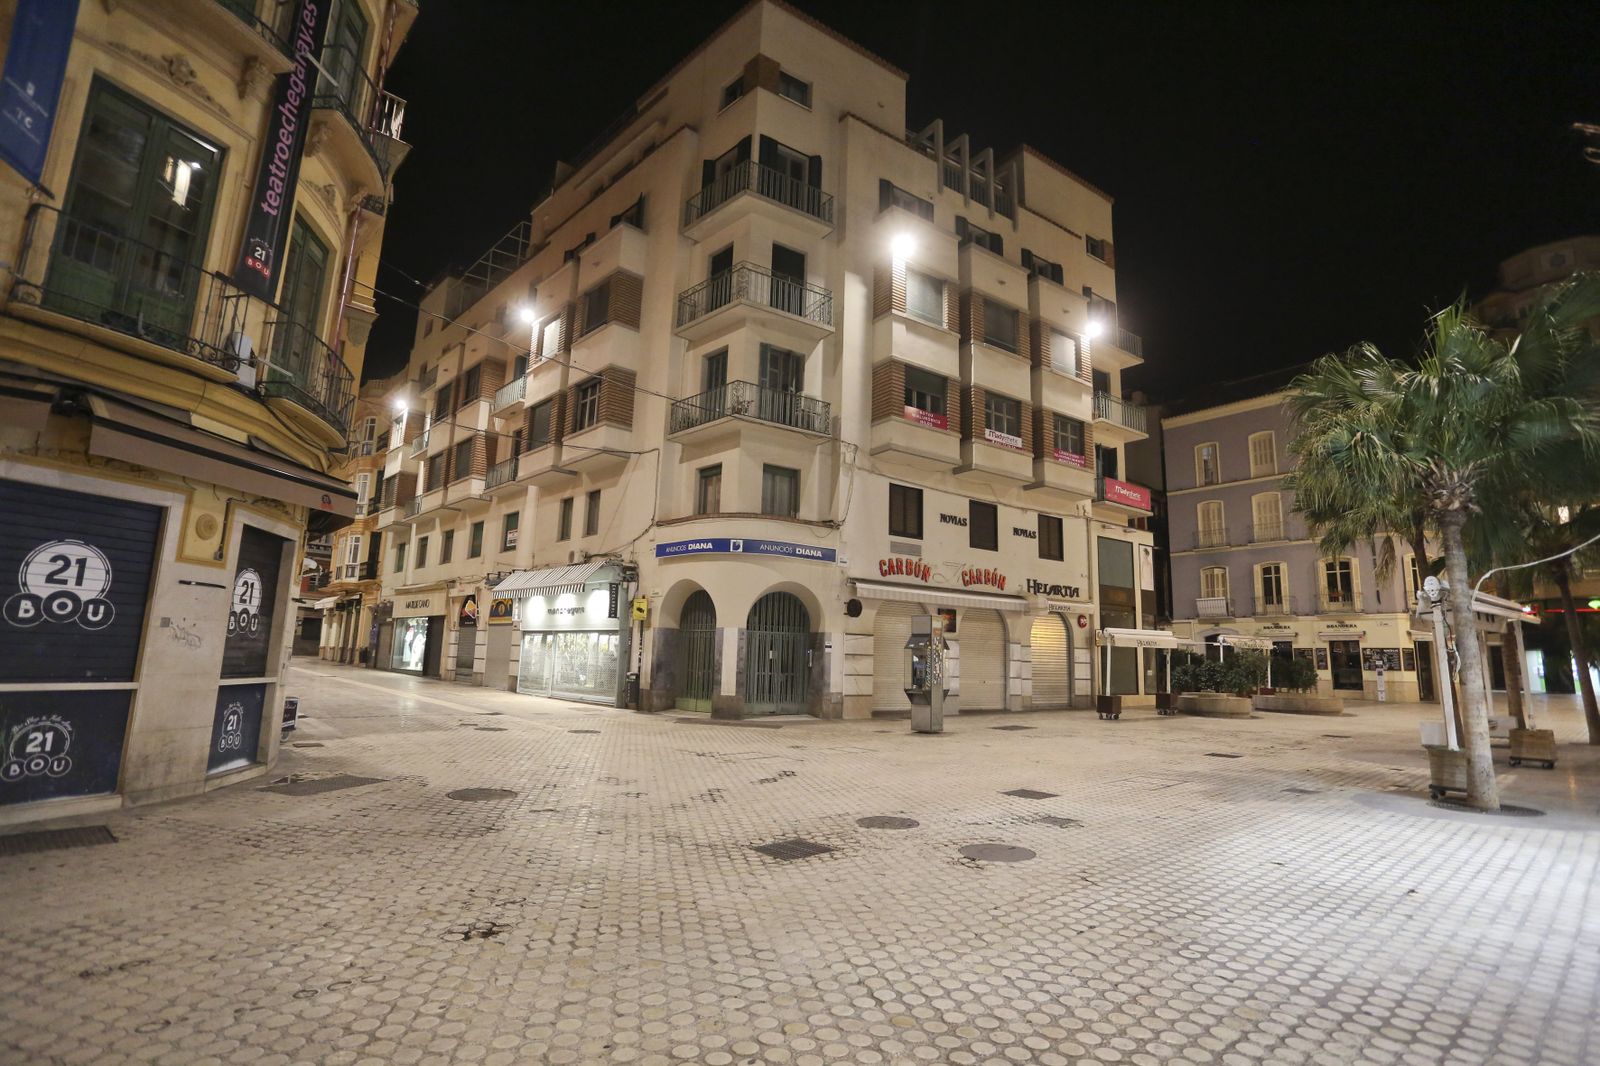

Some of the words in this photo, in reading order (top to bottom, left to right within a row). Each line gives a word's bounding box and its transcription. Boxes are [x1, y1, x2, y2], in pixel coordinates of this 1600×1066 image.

[254, 246, 266, 262] 21
[940, 513, 967, 527] NOVIAS
[1013, 527, 1037, 539] NOVIAS
[666, 544, 686, 553] ANUNCIOS
[687, 542, 713, 551] DIANA
[760, 543, 793, 554] ANUNCIOS
[795, 547, 823, 558] DIANA
[45, 554, 88, 587] 21
[879, 557, 932, 583] CARBÓN
[962, 567, 1007, 591] CARBÓN
[239, 580, 254, 604] 21
[18, 597, 105, 622] BOU
[229, 615, 258, 631] BOU
[227, 714, 238, 731] 21
[25, 731, 54, 753] 21
[9, 759, 65, 776] BOU
